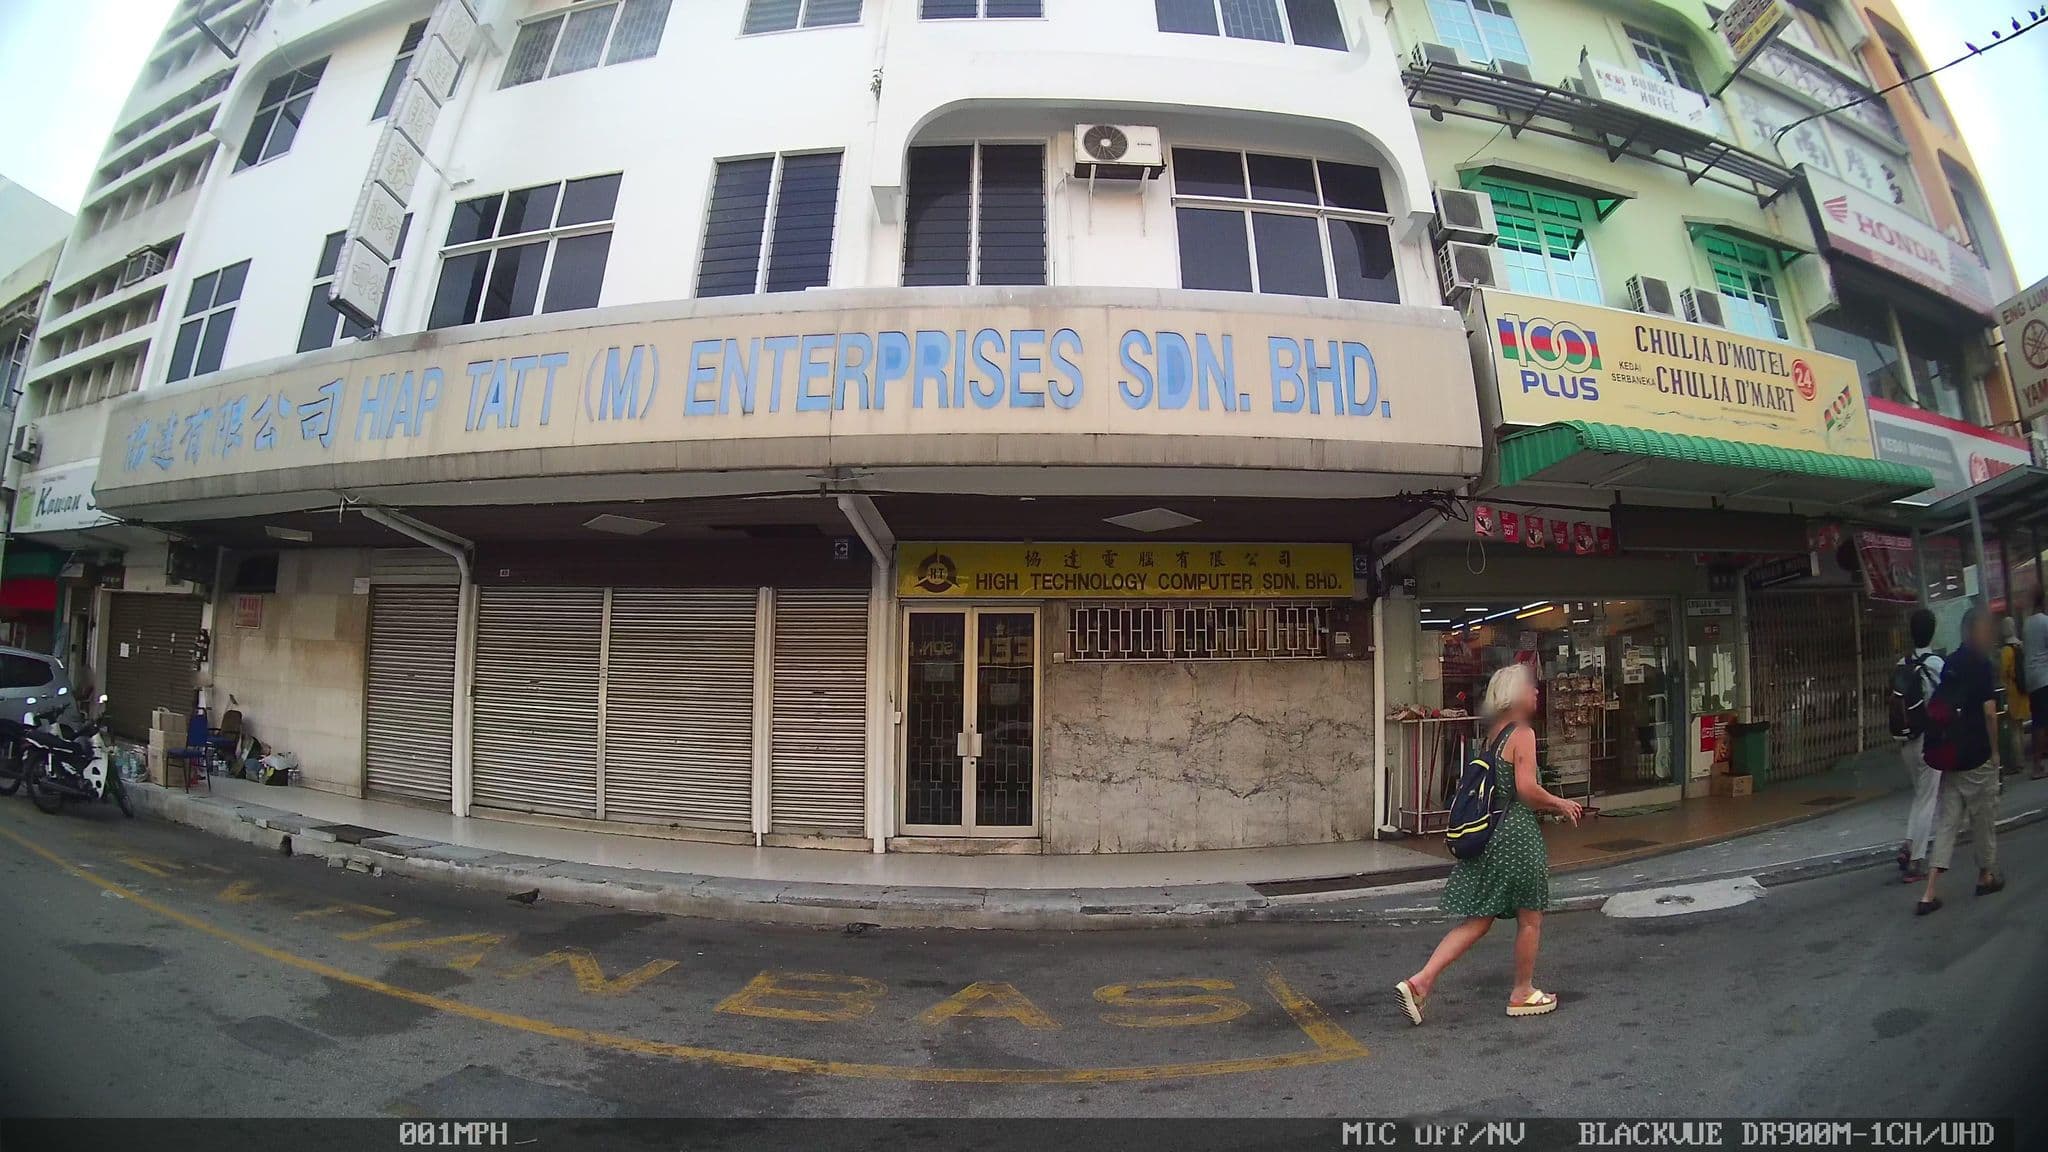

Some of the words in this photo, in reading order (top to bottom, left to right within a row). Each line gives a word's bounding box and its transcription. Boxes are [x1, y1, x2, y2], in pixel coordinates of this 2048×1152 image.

[1853, 211, 1946, 272] HONDA
[2002, 301, 2026, 326] ENG
[1504, 312, 1594, 374] 100
[1635, 325, 1714, 364] CHULIA
[1716, 341, 1791, 378] D'MOTEL
[1611, 373, 1656, 387] SERBANEKA
[1618, 360, 1642, 372] KEDAI
[1794, 366, 1813, 388] 24
[354, 366, 445, 442] HIAP
[464, 351, 570, 432] TATT
[584, 344, 660, 422] (M)
[683, 328, 1084, 417] ENTERPRISES
[1117, 328, 1251, 413] SDN.
[1267, 336, 1392, 418] BHD.
[1520, 369, 1600, 401] PLUS
[1656, 366, 1732, 403] CHULIA
[1735, 377, 1795, 413] D'MART
[35, 487, 82, 517] Kawan
[1024, 549, 1293, 569] 協達電腦有限公司
[976, 572, 1018, 591] HIGH
[1031, 572, 1148, 591] TECHNOLOGY
[1158, 571, 1253, 590] COMPUTER
[1262, 571, 1300, 590] SDN.
[1306, 571, 1342, 590] BHD.
[712, 970, 1251, 1030] BAS
